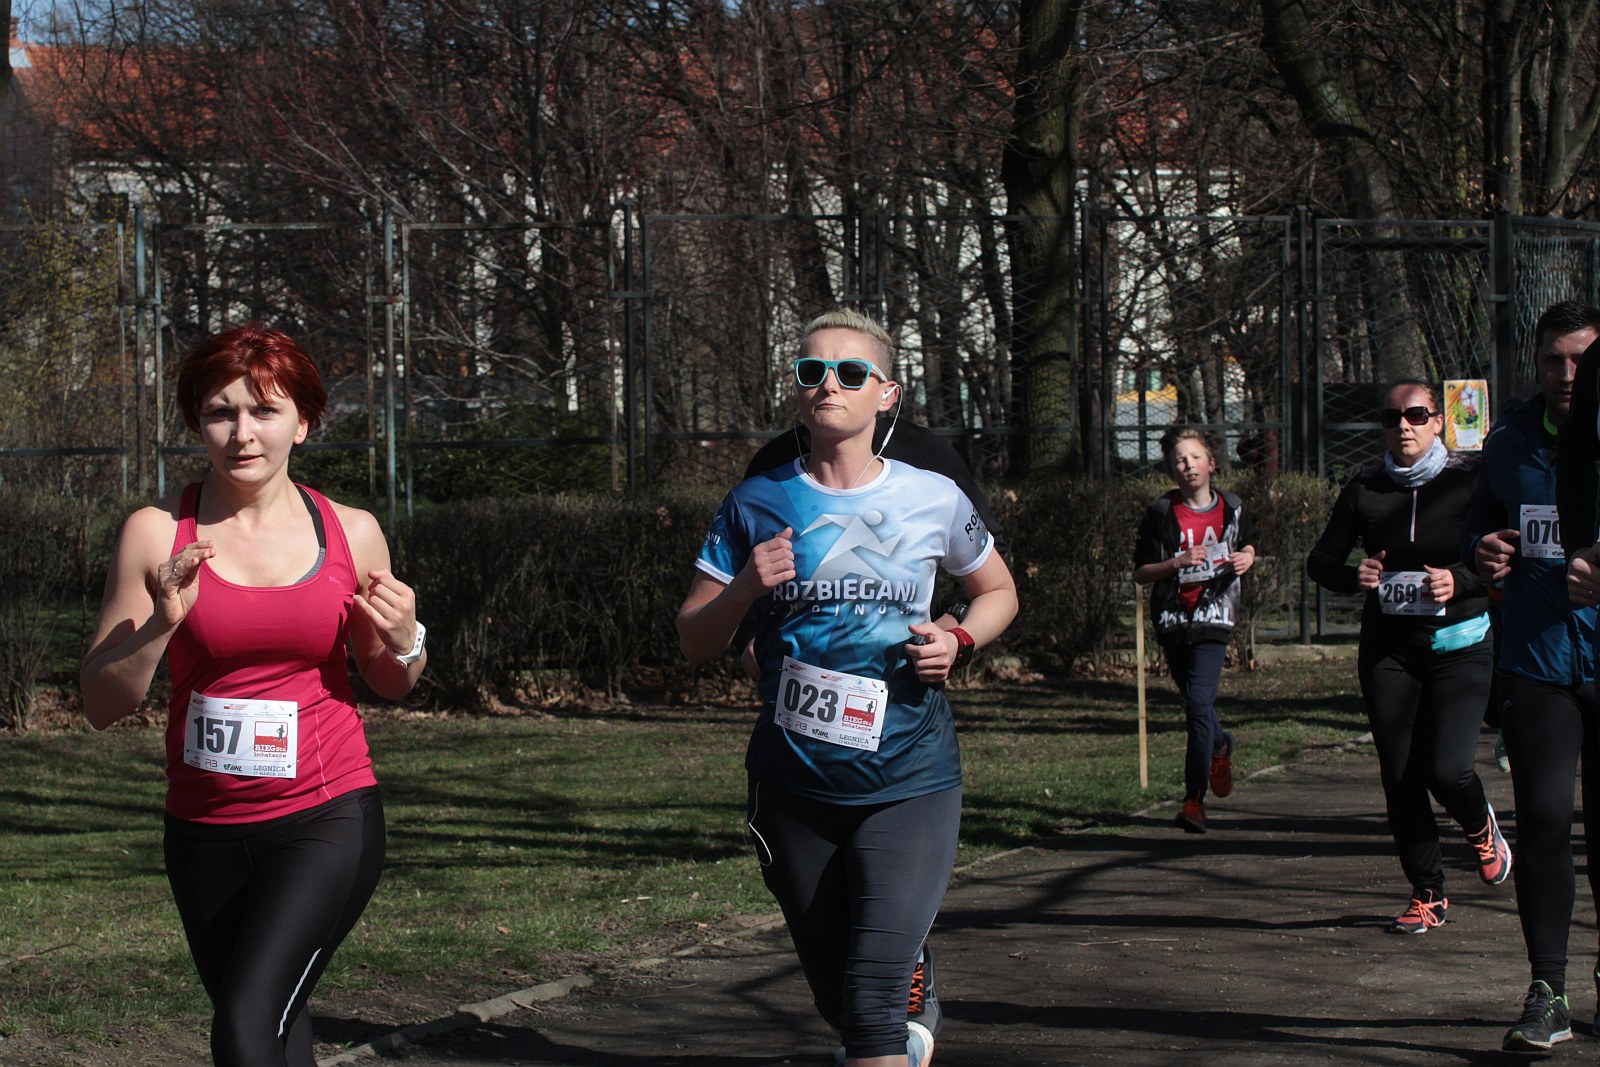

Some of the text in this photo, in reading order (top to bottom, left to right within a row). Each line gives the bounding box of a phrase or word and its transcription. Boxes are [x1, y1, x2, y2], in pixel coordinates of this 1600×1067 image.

[1527, 519, 1560, 545] 070
[772, 578, 918, 602] ROZBIEGANI
[1383, 583, 1417, 604] 269
[784, 678, 839, 722] 023
[844, 714, 862, 725] BIEG
[193, 716, 242, 754] 157
[839, 733, 869, 744] LEGNICA
[254, 744, 275, 752] BIEG
[253, 764, 286, 772] LEGNICA
